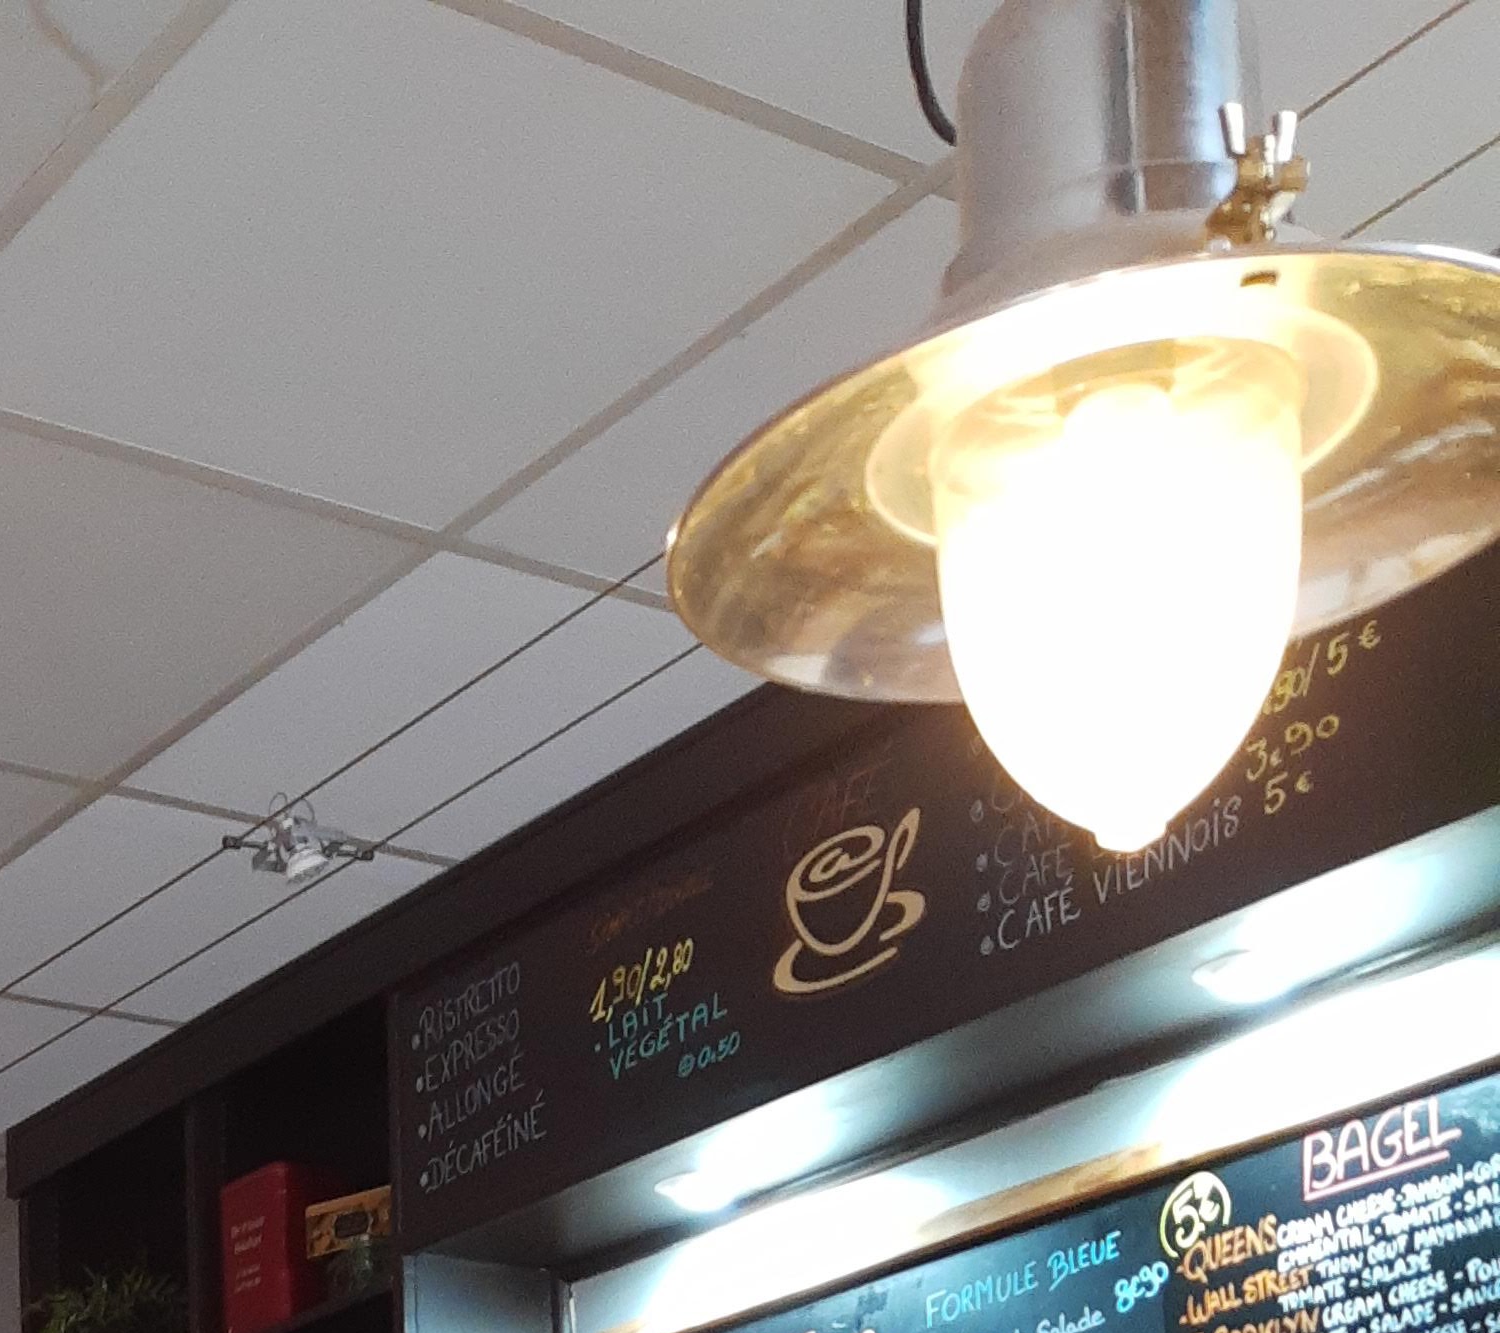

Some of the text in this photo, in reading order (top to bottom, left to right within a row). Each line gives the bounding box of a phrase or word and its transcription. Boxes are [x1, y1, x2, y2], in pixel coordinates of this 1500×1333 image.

[997, 874, 1081, 950] CAFÉ
[424, 1008, 519, 1091] EXPRESSO
[428, 1044, 525, 1142] ALLONGÉ
[1303, 1096, 1462, 1201] BAGEL
[926, 1231, 1121, 1328] FORMULE BLEUE
[1183, 1214, 1277, 1282] QUEENS
[1278, 1249, 1432, 1312] TOMATE SALADE
[1186, 1284, 1243, 1325] WALL
[1322, 1291, 1385, 1328] CREAM
[1388, 1270, 1448, 1306] CHEESE
